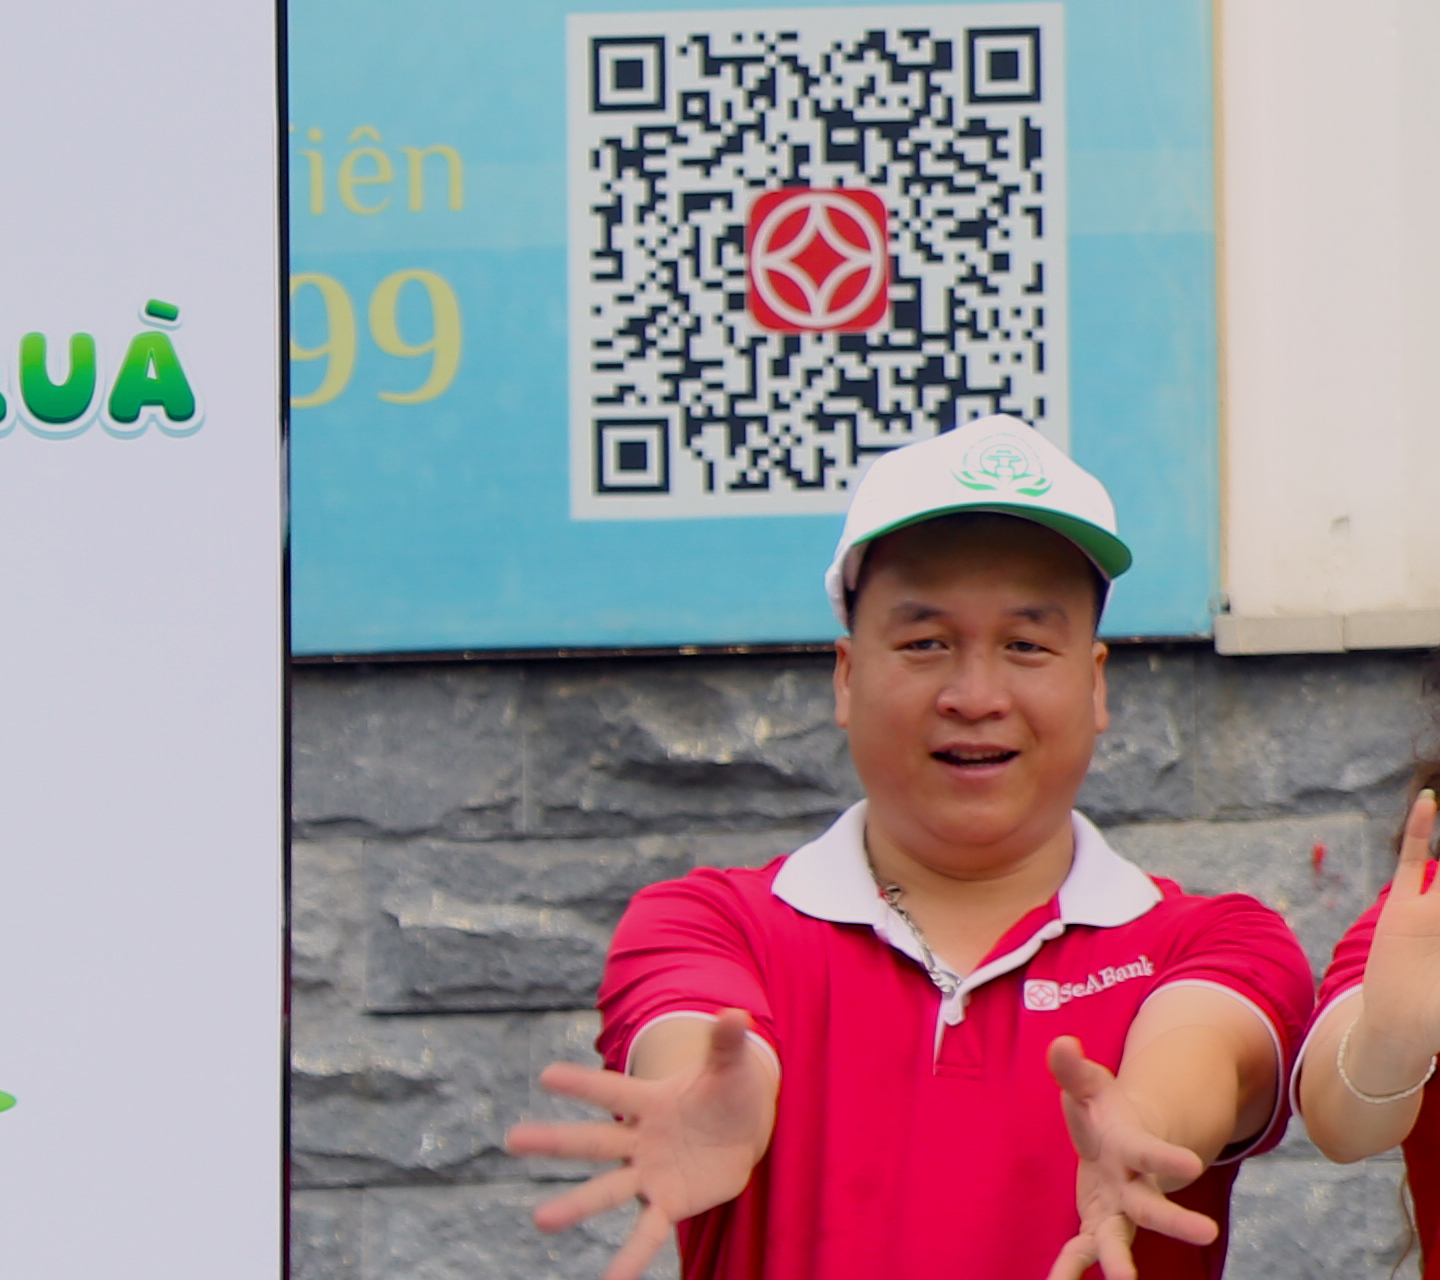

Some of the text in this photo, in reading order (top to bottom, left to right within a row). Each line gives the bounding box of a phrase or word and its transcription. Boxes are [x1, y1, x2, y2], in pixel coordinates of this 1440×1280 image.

[294, 124, 464, 216] iên
[0, 299, 196, 425] UÀ
[1059, 955, 1154, 1003] SeABank
